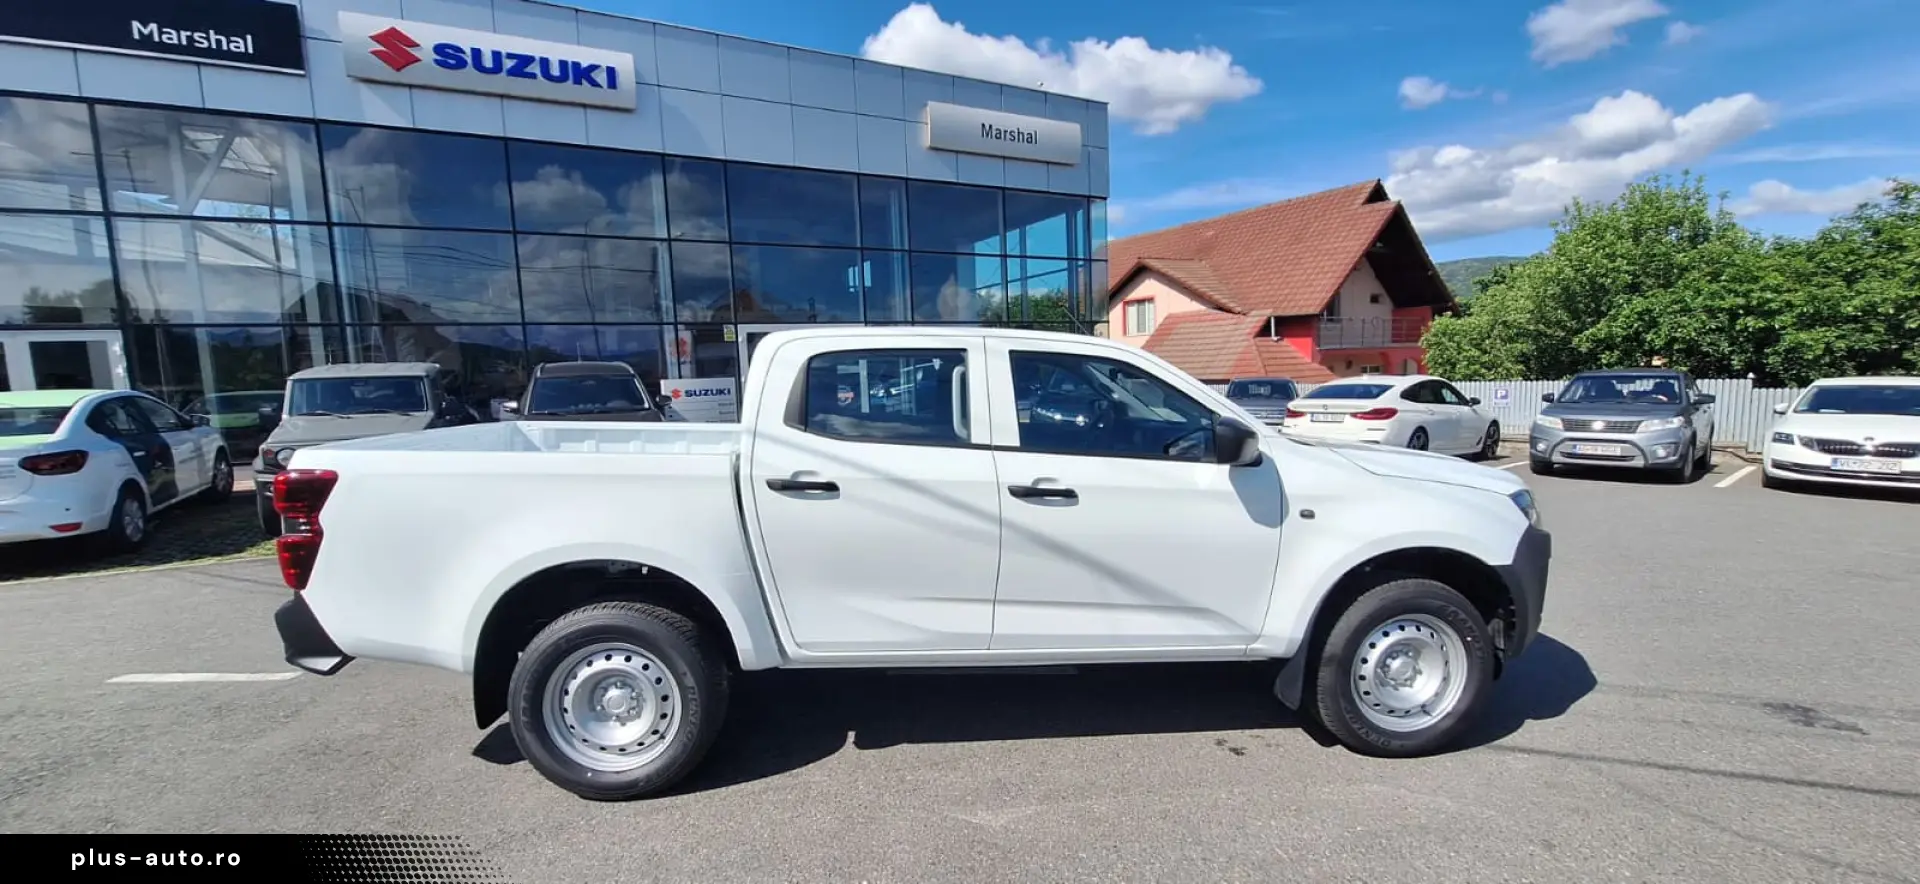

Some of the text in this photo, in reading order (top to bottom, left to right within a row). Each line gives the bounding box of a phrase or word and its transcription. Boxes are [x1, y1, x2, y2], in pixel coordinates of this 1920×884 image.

[131, 19, 254, 54] Marshal
[432, 42, 618, 90] SUZUKI
[981, 122, 1038, 145] Marshal
[684, 387, 731, 398] SUZUKI
